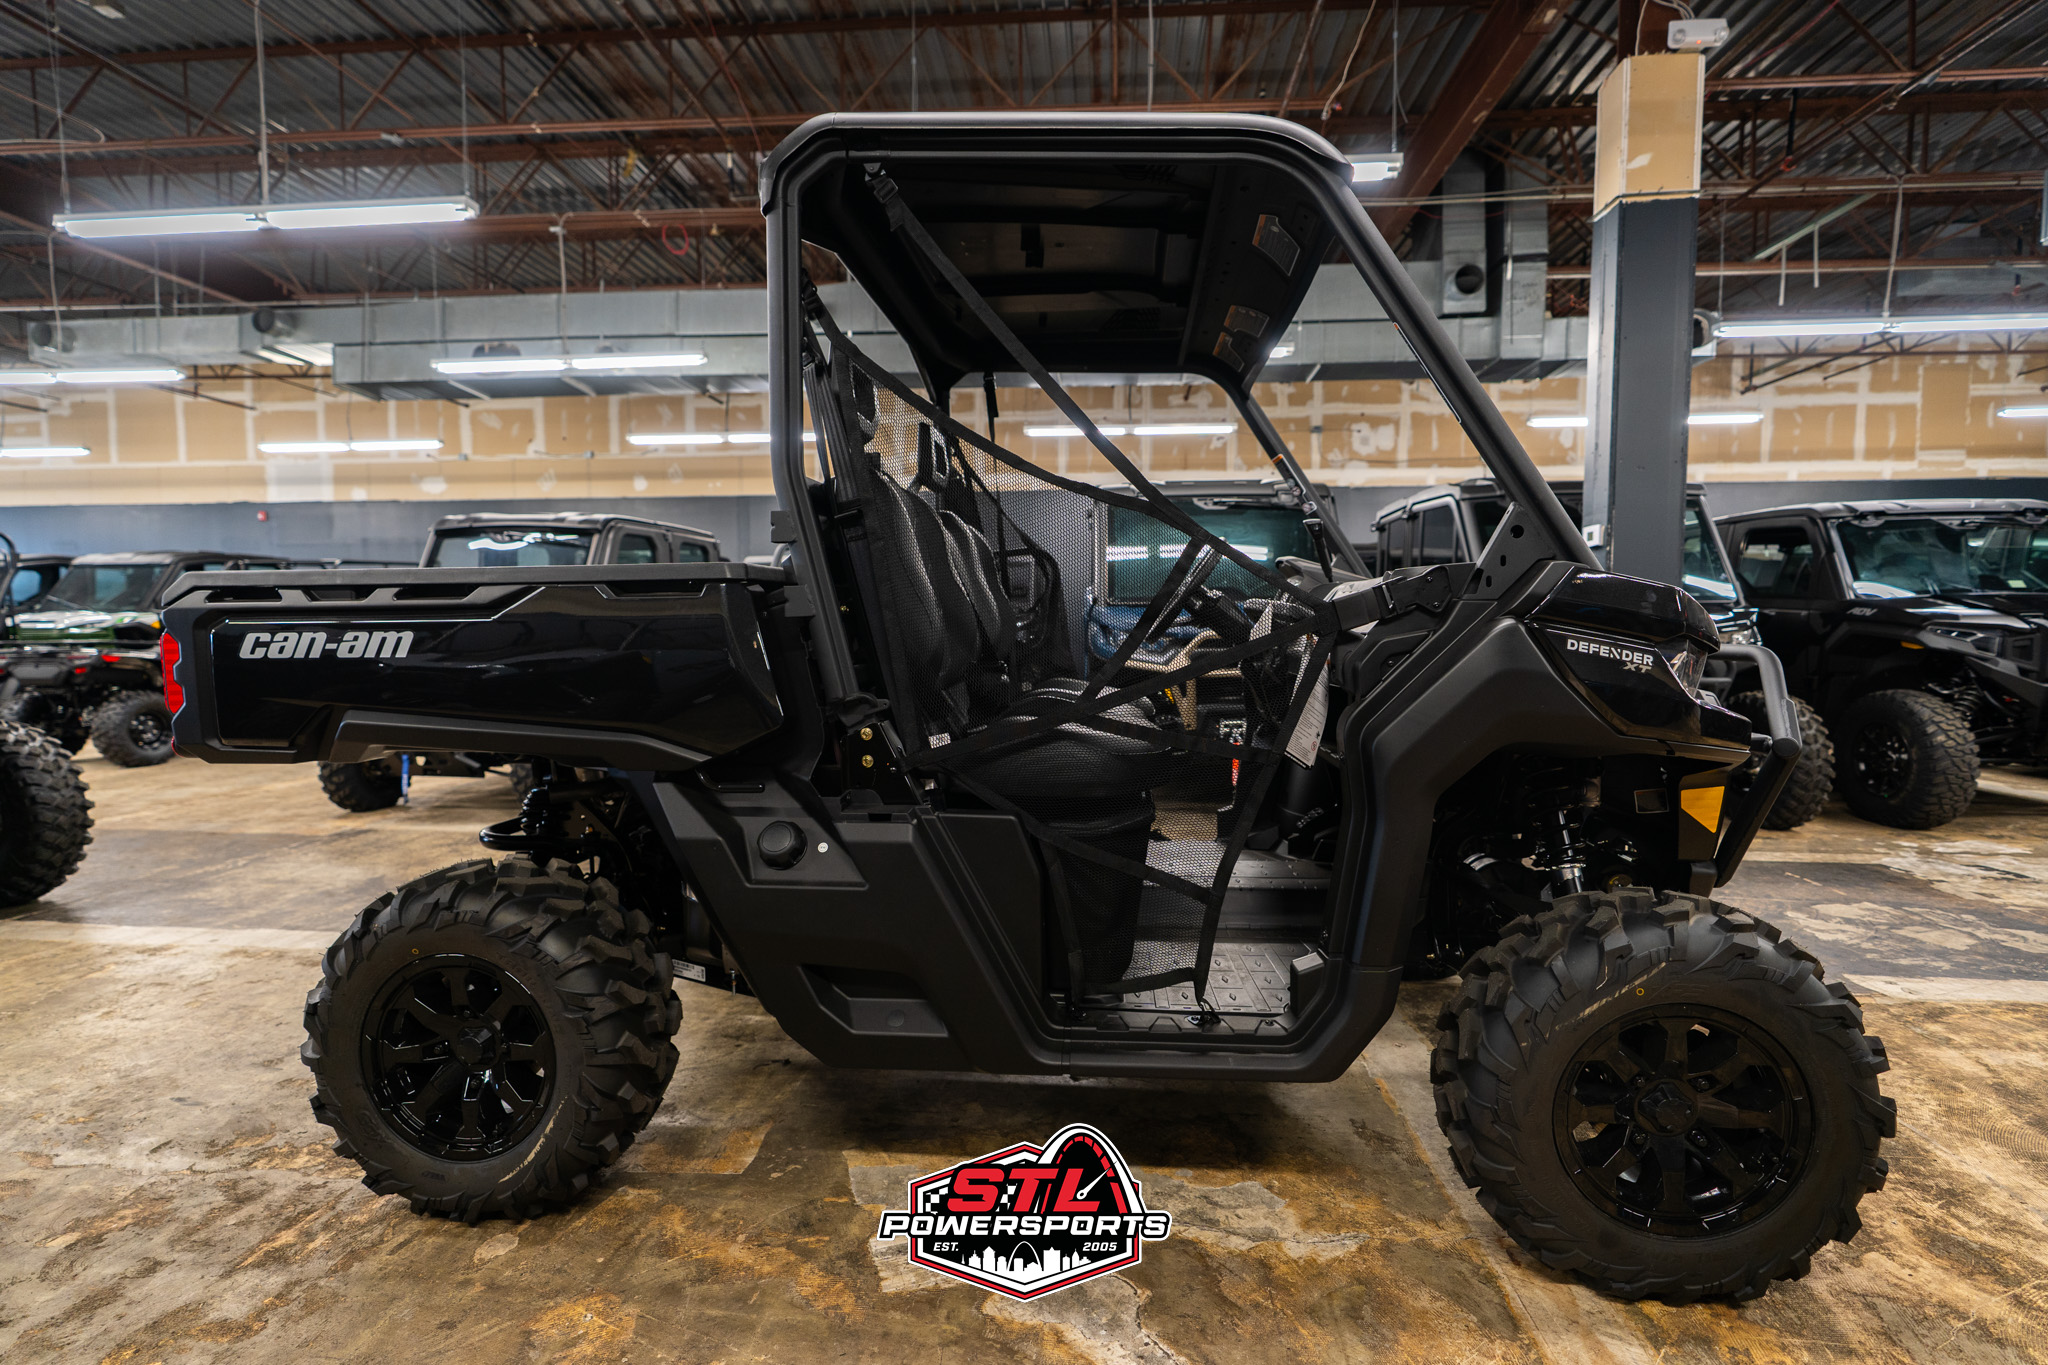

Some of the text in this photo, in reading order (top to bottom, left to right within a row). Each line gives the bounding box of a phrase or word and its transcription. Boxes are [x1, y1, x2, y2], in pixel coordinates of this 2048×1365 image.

[239, 630, 414, 659] can-am
[1566, 638, 1654, 666] DEFENDER
[1623, 661, 1652, 674] XT
